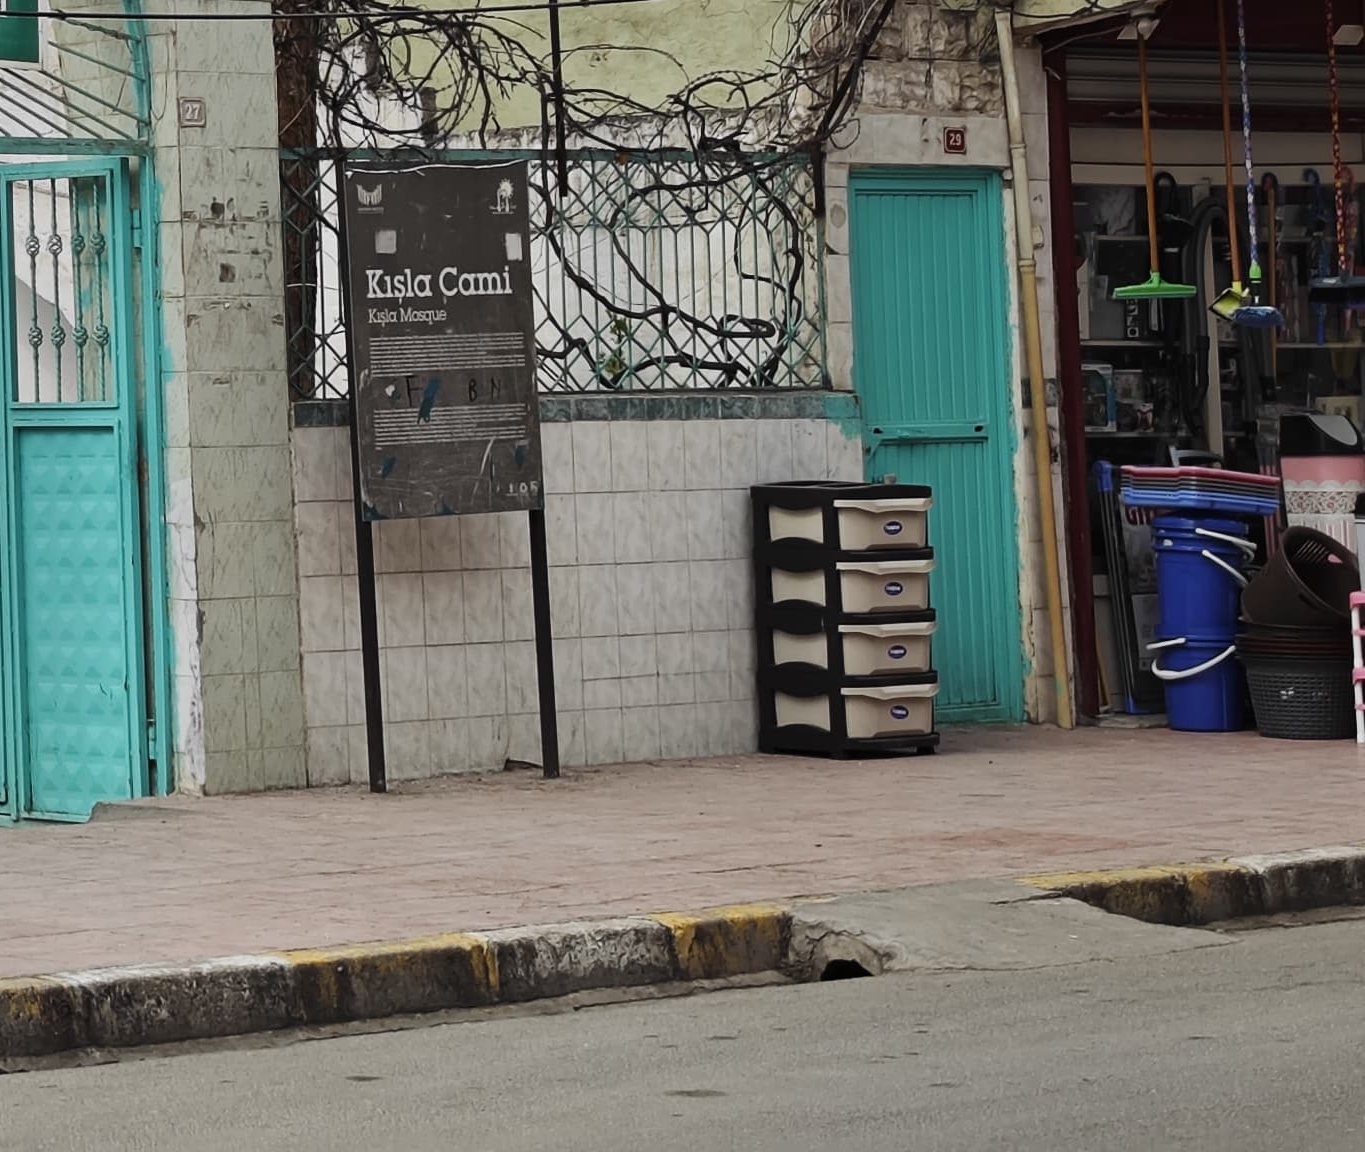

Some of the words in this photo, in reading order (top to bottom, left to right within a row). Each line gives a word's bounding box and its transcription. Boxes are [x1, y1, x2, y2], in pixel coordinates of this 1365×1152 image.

[185, 103, 201, 121] 27
[949, 133, 961, 146] 29
[365, 268, 433, 305] Kışla
[368, 308, 398, 328] Kışla
[400, 306, 447, 325] Mosque
